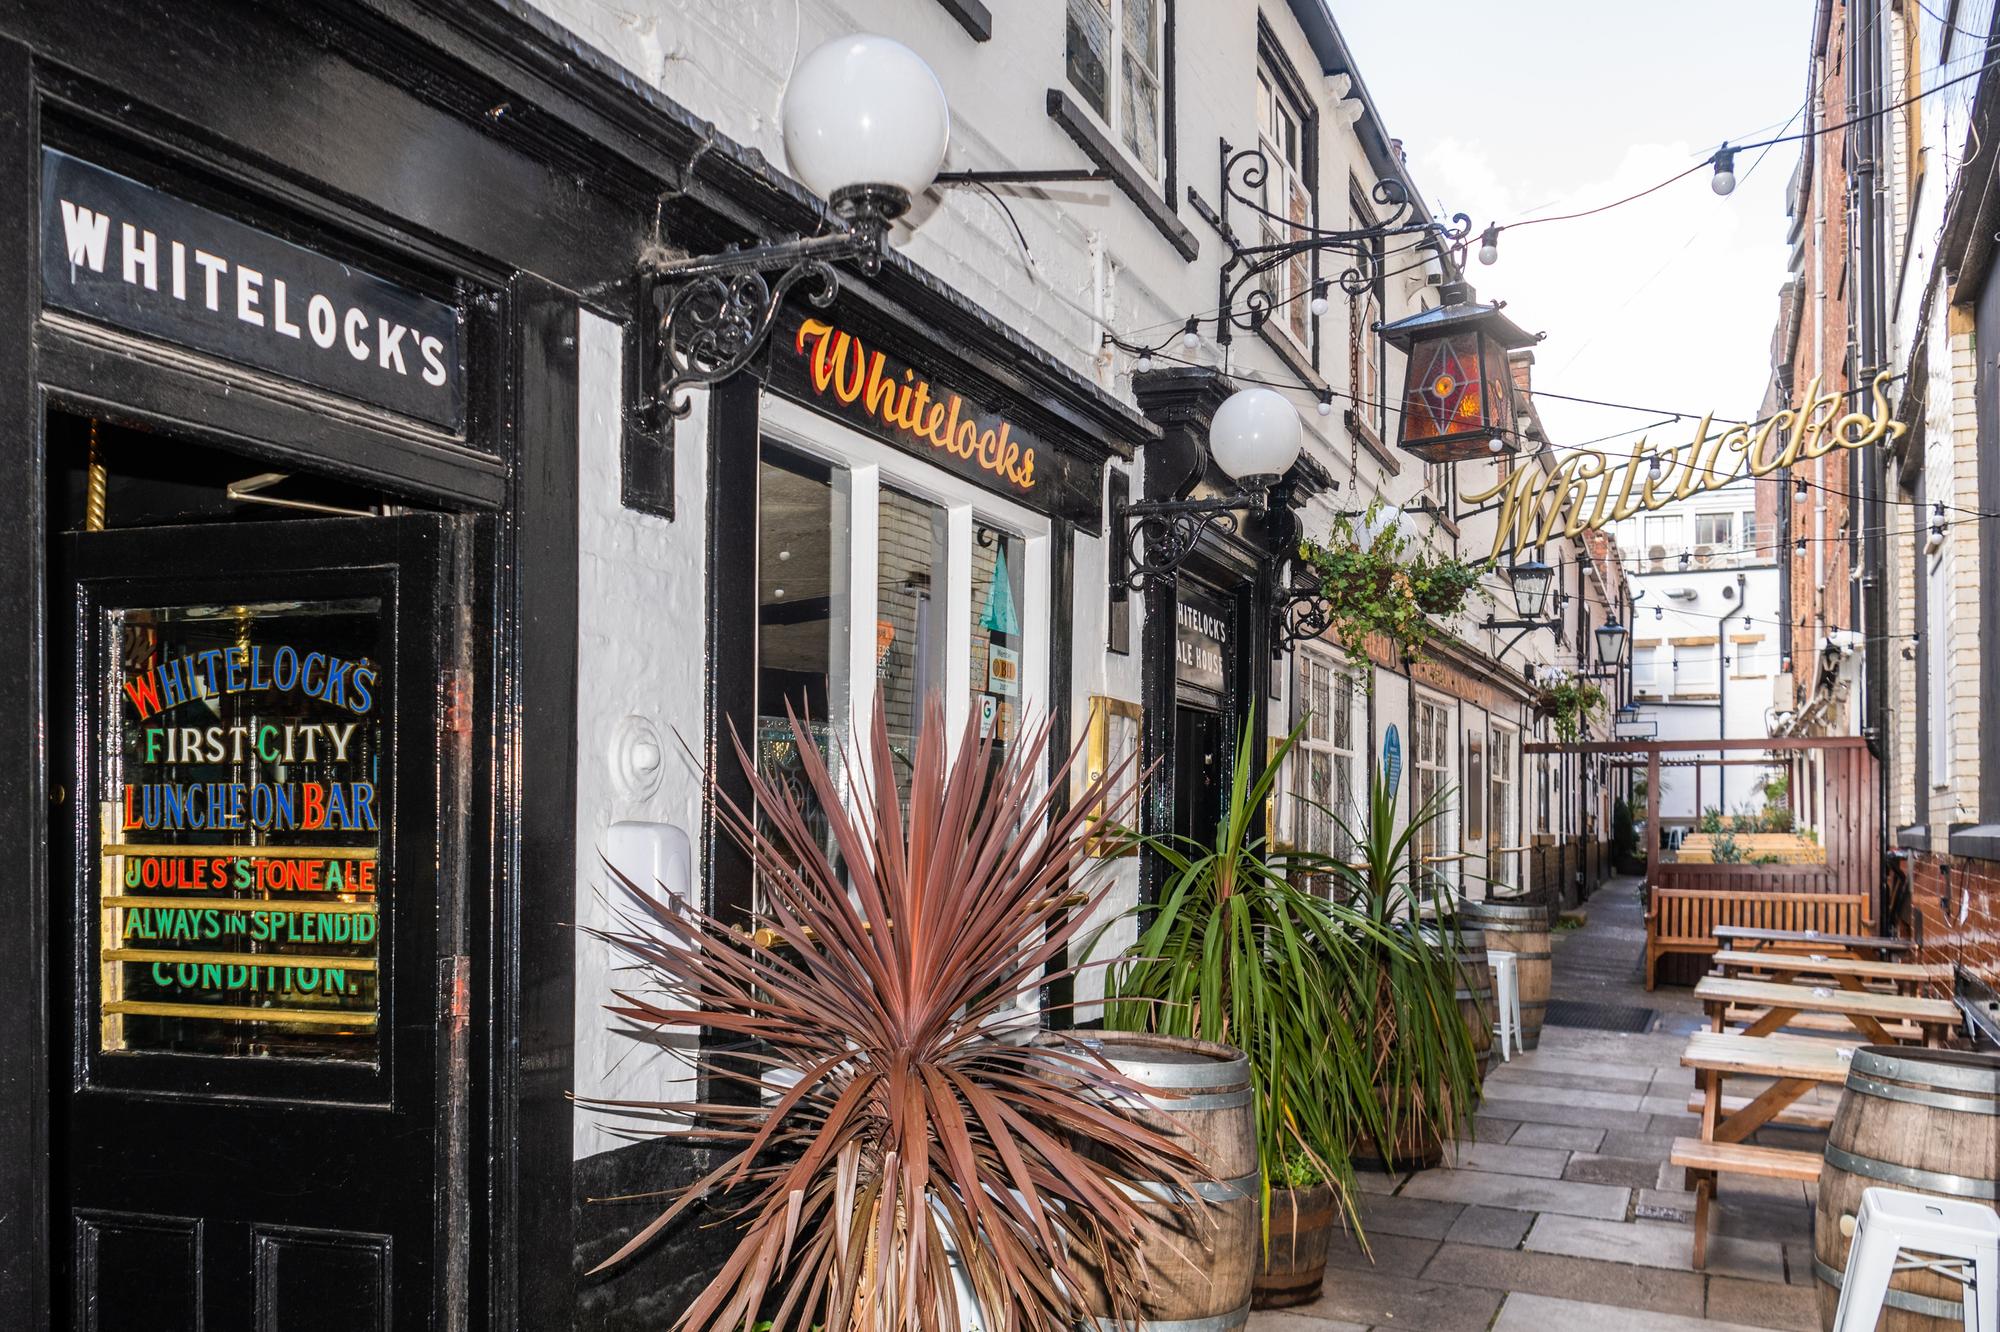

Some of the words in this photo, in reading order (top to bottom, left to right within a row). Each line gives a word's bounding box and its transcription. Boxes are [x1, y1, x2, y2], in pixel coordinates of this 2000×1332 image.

[60, 200, 447, 386] WHITELOCK'S
[797, 318, 1036, 490] Whitelocks
[1459, 370, 1907, 560] Whitelocks
[1177, 602, 1226, 643] HITELOCK'S
[1176, 640, 1193, 666] ALE
[1196, 646, 1224, 677] HOUSE
[145, 725, 248, 763] FIRST
[257, 723, 357, 763] CITY
[123, 783, 295, 831] LUNCHEON
[302, 783, 378, 831] BAR
[234, 859, 323, 891] STONE
[325, 860, 376, 892] ALE
[123, 908, 221, 940] ALWAYS
[225, 914, 247, 935] IN
[251, 912, 377, 944] SPLENDID
